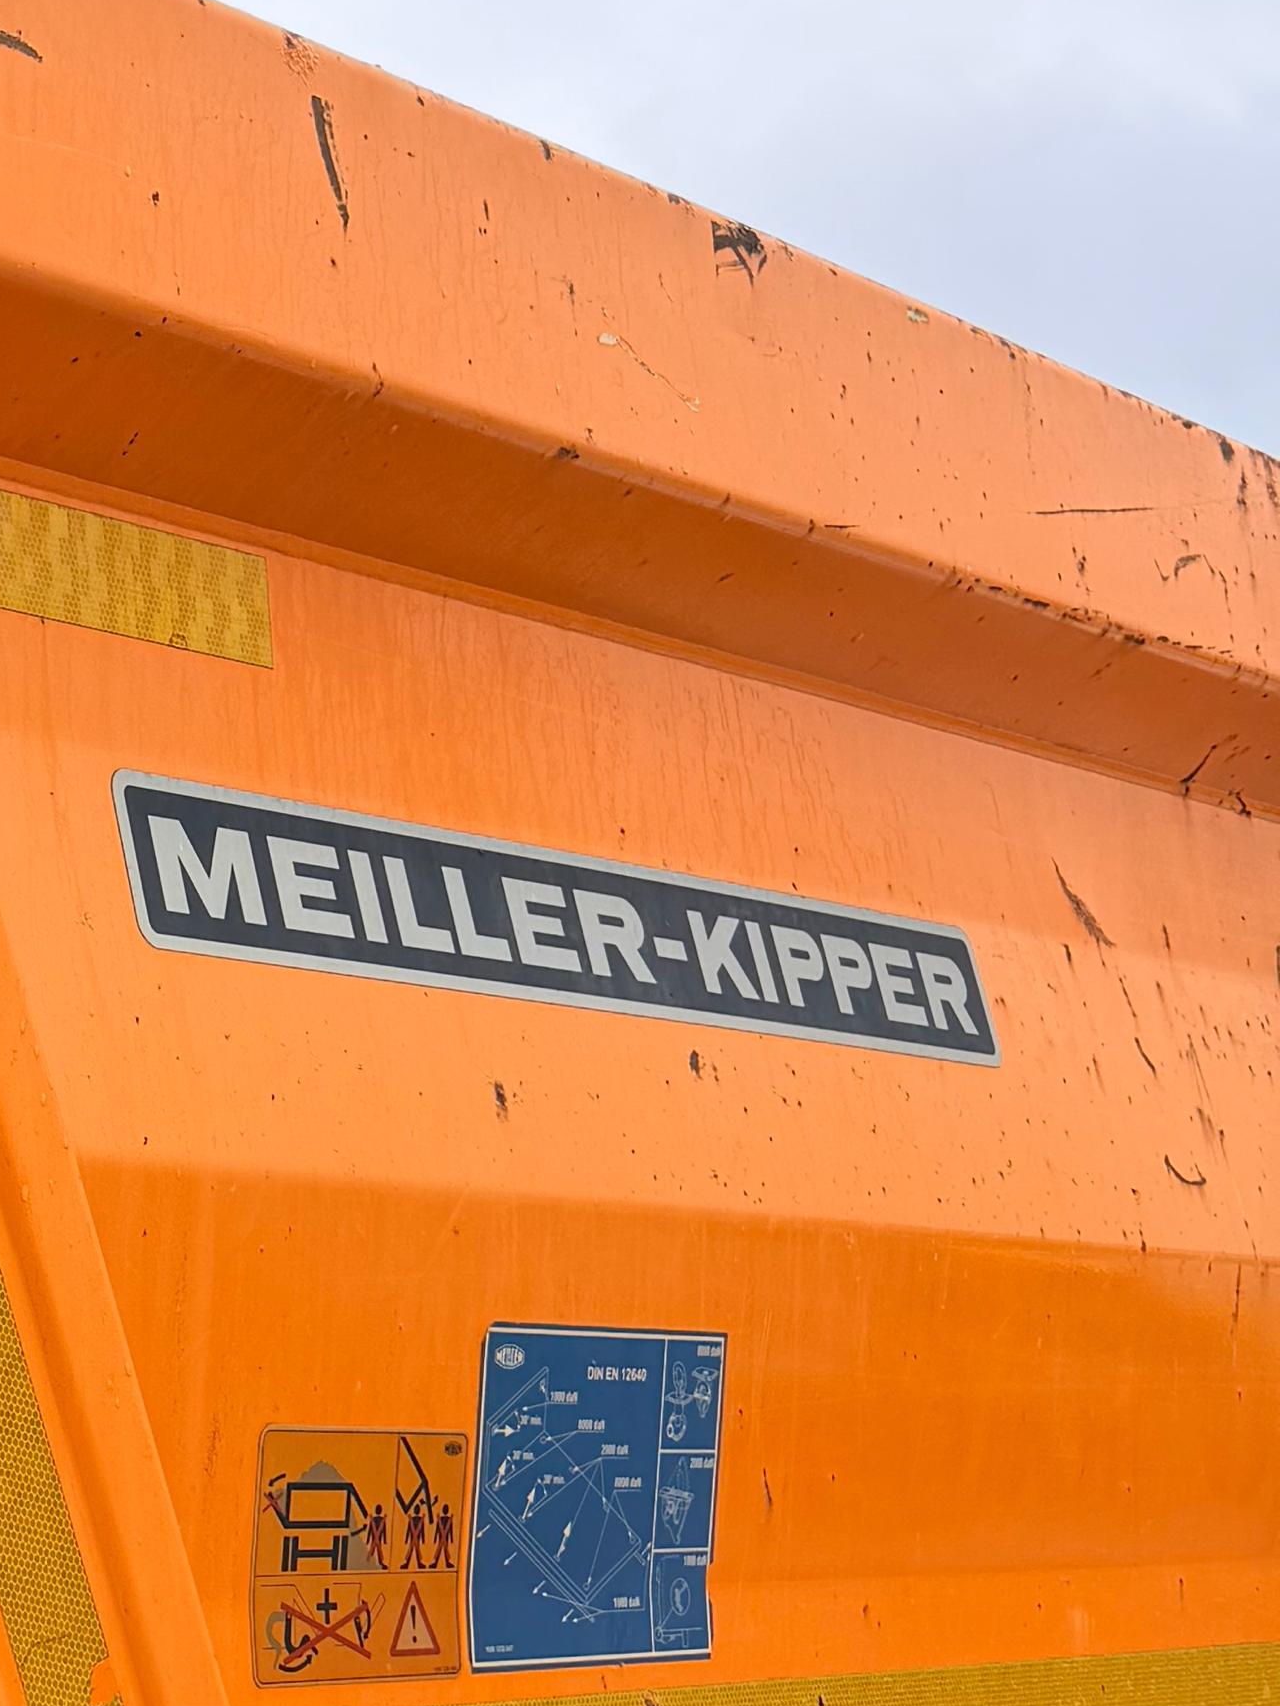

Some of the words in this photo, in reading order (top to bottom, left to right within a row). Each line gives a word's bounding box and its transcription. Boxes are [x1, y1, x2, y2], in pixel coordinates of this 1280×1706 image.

[147, 815, 980, 1036] MEILLER-KIPPER
[587, 1366, 604, 1381] DIN
[605, 1367, 619, 1381] EN
[621, 1368, 647, 1382] 12640
